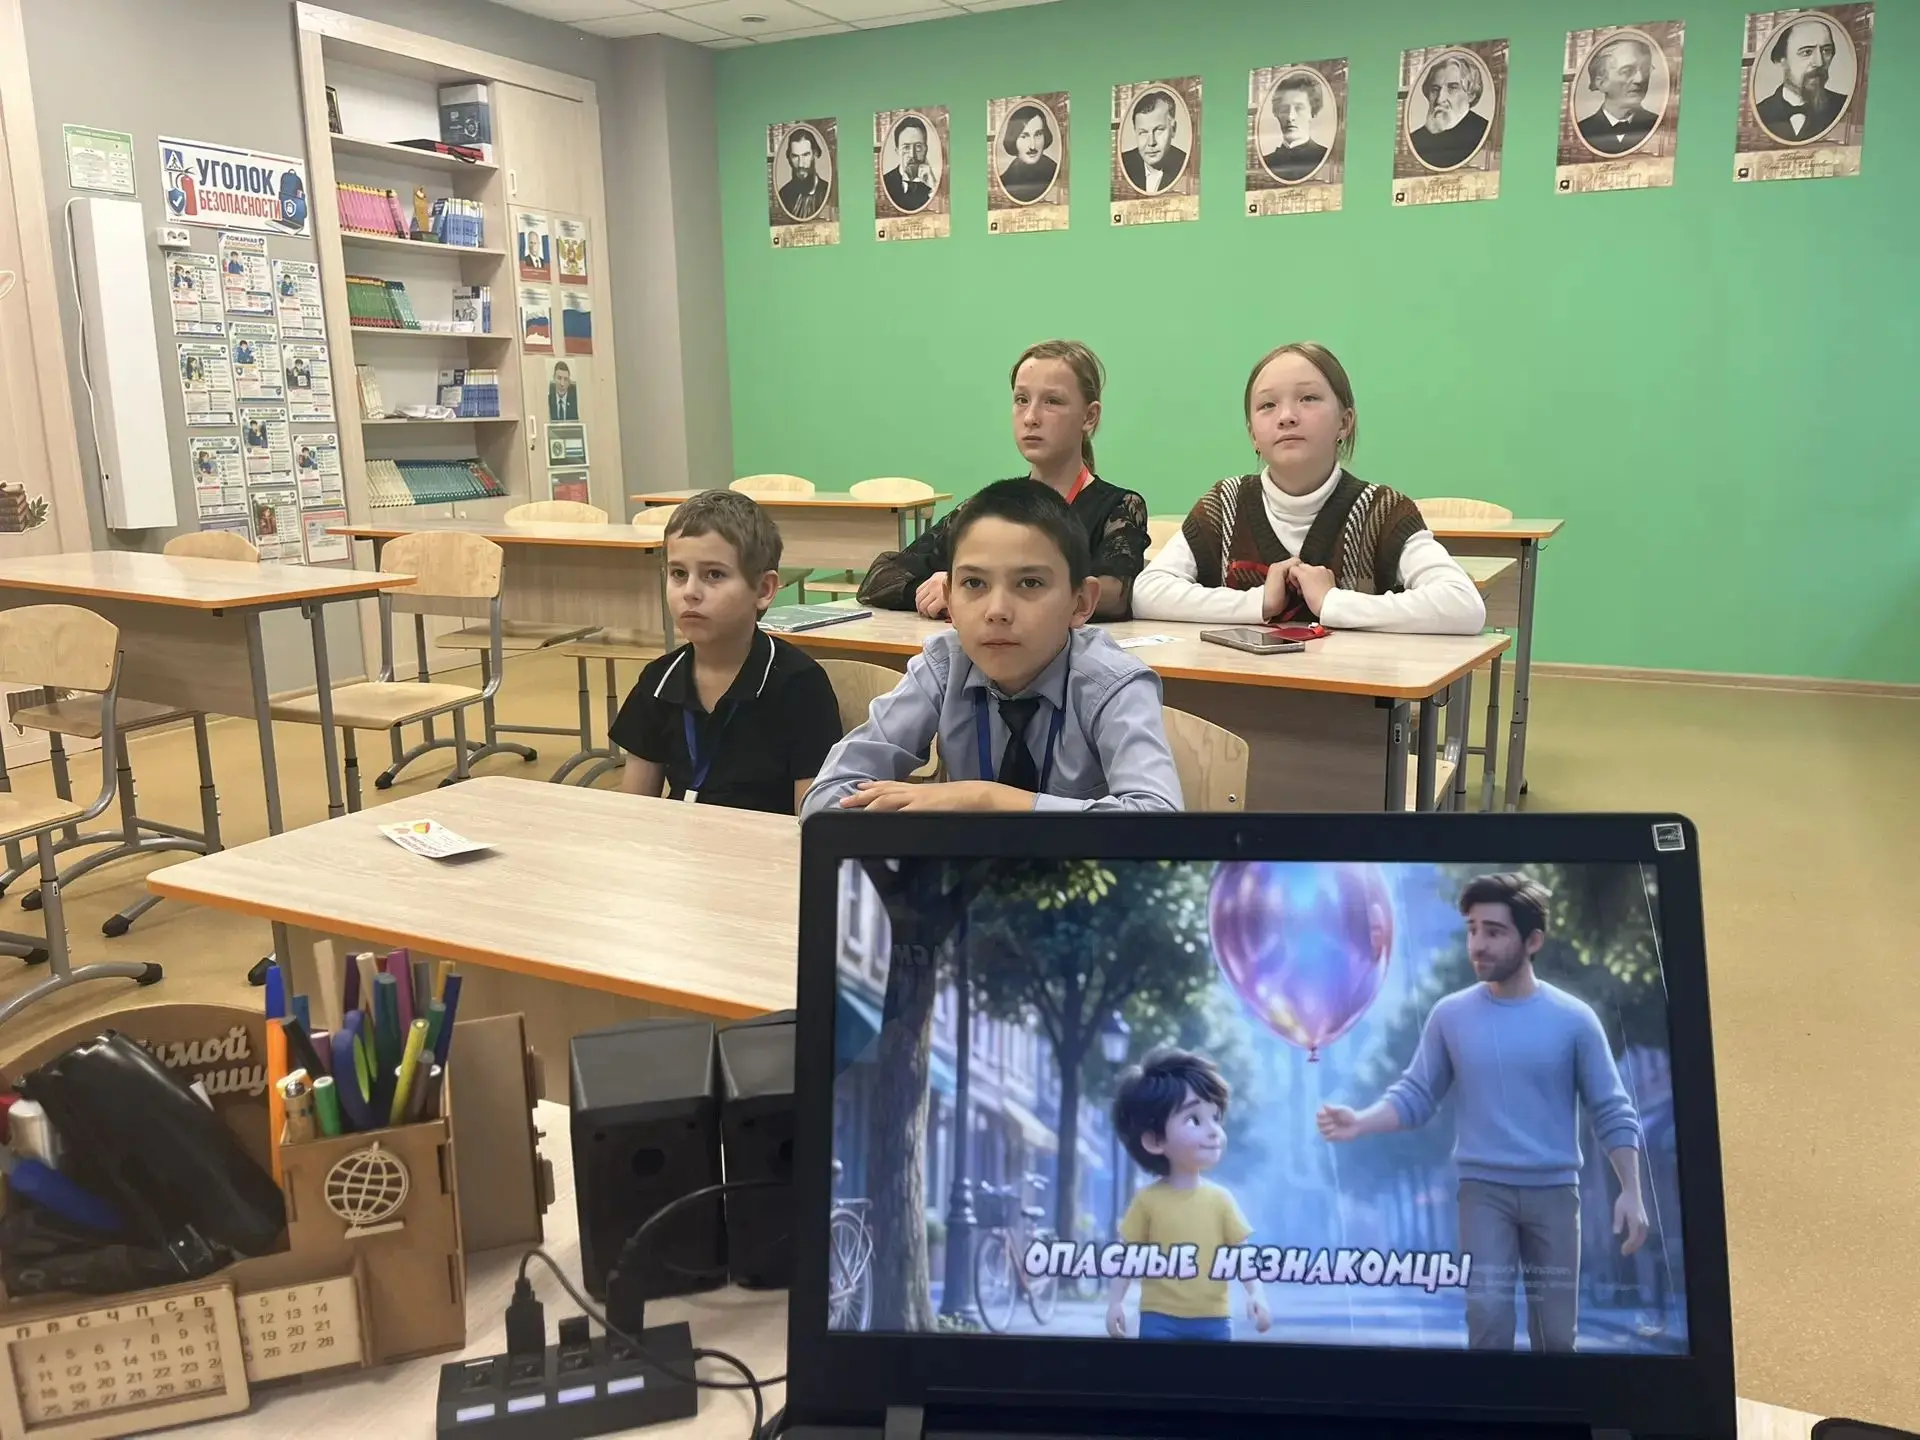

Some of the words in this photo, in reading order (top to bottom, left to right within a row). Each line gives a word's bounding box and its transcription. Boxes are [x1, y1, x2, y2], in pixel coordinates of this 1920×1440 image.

[196, 158, 275, 195] УГОЛОК
[200, 189, 282, 220] БЕЗОПАСНОСТИ
[1024, 1241, 1198, 1280] ОПАСНЫЕ
[1209, 1245, 1472, 1292] НЕЗНАКОМЦЫ
[260, 1296, 269, 1308] 5
[287, 1292, 297, 1302] 6
[315, 1286, 324, 1297] 7
[16, 1327, 30, 1339] П
[77, 1316, 90, 1328] С
[107, 1311, 119, 1322] Ч
[137, 1306, 148, 1317] П
[165, 1301, 177, 1313] С
[194, 1296, 206, 1308] В
[149, 1317, 155, 1327] 1
[175, 1312, 184, 1323] 2
[258, 1313, 275, 1325] 12
[286, 1308, 302, 1321] 13
[313, 1303, 328, 1315] 14
[122, 1338, 131, 1350] 7
[179, 1329, 188, 1339] 9
[260, 1330, 277, 1342] 19
[286, 1325, 304, 1338] 20
[314, 1320, 331, 1332] 21
[95, 1360, 111, 1372] 13
[123, 1355, 138, 1367] 14
[150, 1350, 168, 1362] 15
[178, 1345, 195, 1357] 16
[206, 1341, 219, 1352] 17
[263, 1347, 281, 1359] 26
[290, 1341, 307, 1354] 27
[317, 1336, 335, 1349] 28
[126, 1372, 143, 1384] 21
[153, 1367, 171, 1379] 22
[181, 1362, 199, 1374] 23
